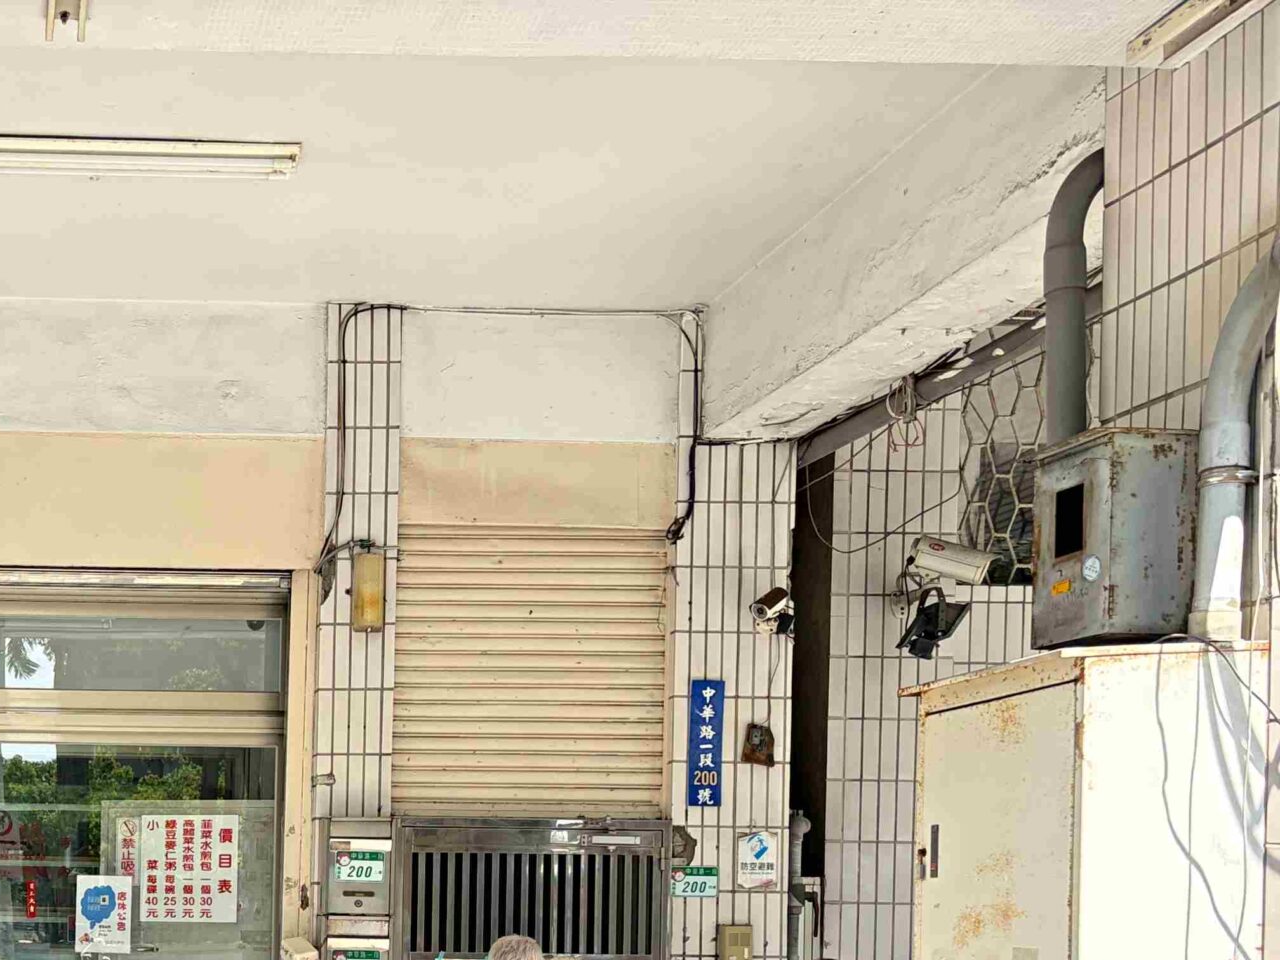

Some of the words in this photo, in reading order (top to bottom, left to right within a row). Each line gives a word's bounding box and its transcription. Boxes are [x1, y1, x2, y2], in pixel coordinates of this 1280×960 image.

[217, 828, 233, 894] 價目表
[347, 866, 373, 878] 200
[682, 881, 707, 893] 200
